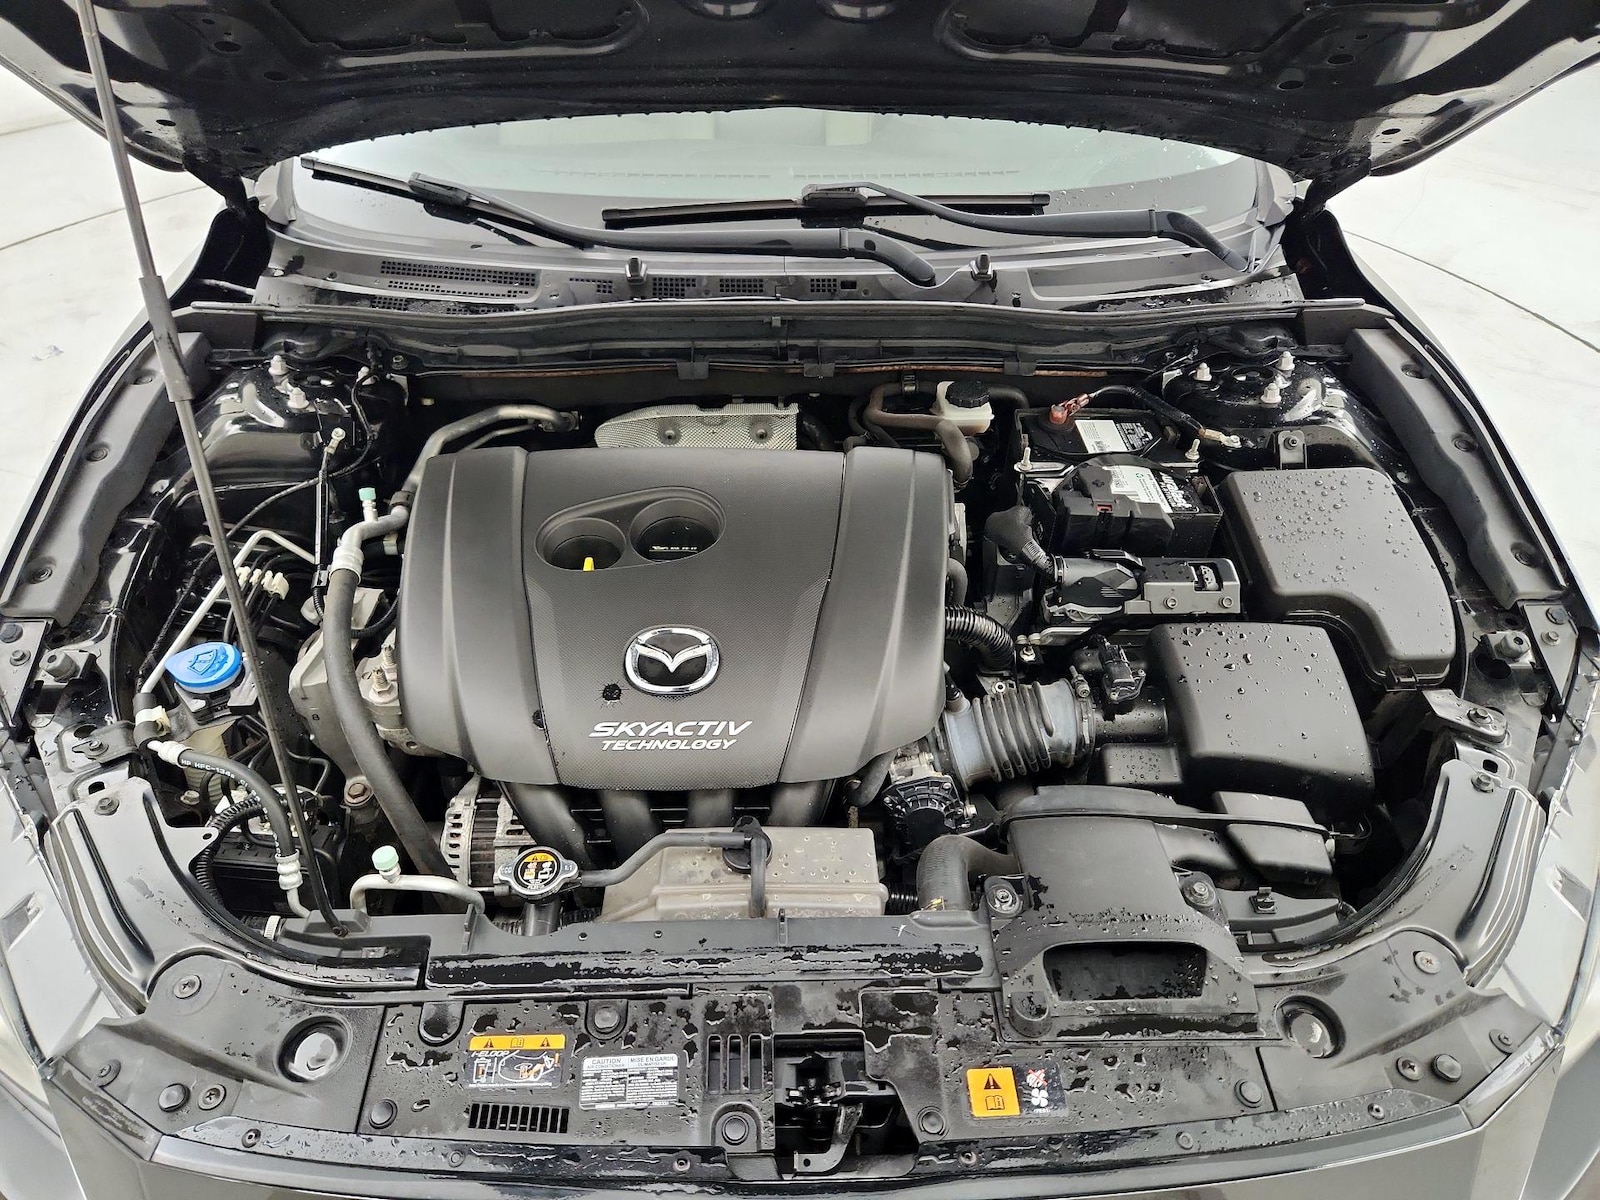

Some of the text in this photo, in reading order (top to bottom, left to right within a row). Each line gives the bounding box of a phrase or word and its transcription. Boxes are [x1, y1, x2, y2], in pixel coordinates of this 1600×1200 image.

[588, 720, 753, 738] SKYACTIV
[601, 739, 737, 751] TECHNOLOGY
[181, 758, 235, 779] HP HFC-134a
